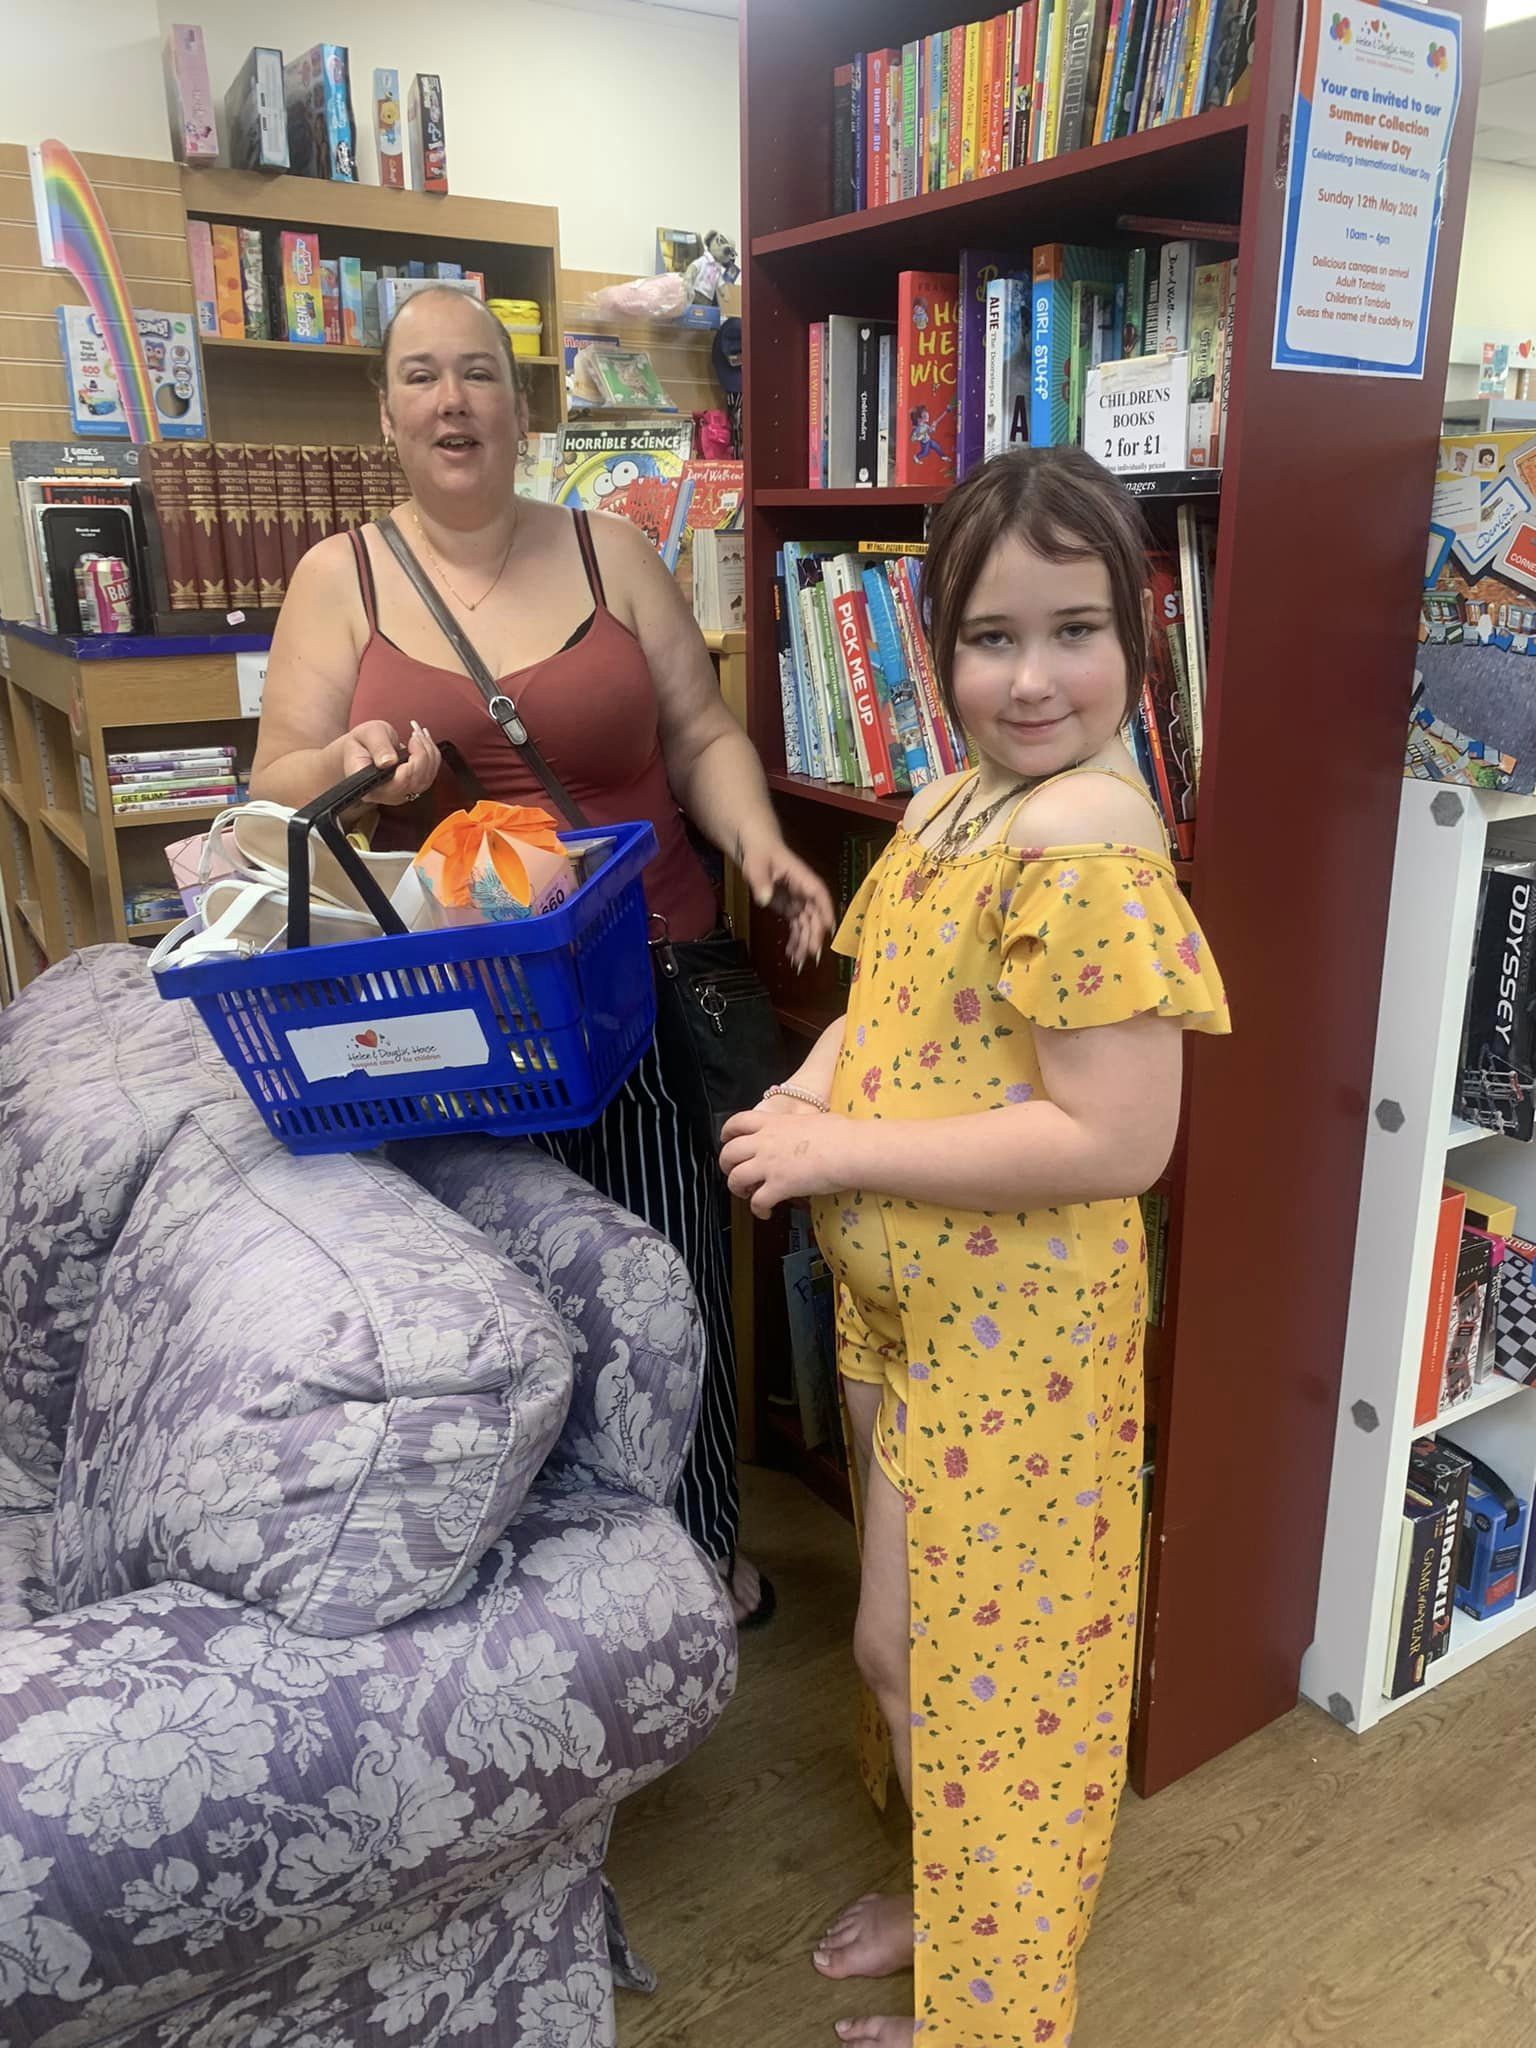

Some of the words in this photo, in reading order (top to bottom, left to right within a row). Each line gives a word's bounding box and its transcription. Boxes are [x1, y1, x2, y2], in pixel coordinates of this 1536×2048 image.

[1321, 78, 1348, 97] Your
[1350, 88, 1369, 101] are
[1372, 88, 1409, 110] invited
[1411, 98, 1422, 112] to
[1424, 104, 1442, 117] our
[1329, 104, 1376, 127] Summer
[1379, 114, 1430, 137] Collection
[1345, 131, 1390, 152] Preview
[1391, 140, 1412, 160] Day
[1312, 148, 1354, 167] Celebrating
[1355, 156, 1398, 173] International
[1318, 188, 1354, 209] Sunday
[1357, 194, 1377, 210] 12th
[1379, 198, 1398, 216] May
[1398, 202, 1419, 218] 2024
[1345, 227, 1368, 242] 10am
[1312, 255, 1346, 271] Delicious
[1336, 275, 1357, 288] Adult
[1325, 291, 1362, 306] Children's
[989, 297, 1000, 331] ALFIE
[1036, 297, 1049, 340] GIRL
[1297, 305, 1320, 318] Guess
[1321, 307, 1334, 320] the
[1335, 311, 1358, 323] name
[1099, 388, 1171, 409] CHILDRENS
[1113, 411, 1155, 428] BOOKS
[565, 431, 627, 450] HORRIBLE
[630, 431, 680, 450] SCIENCE
[1104, 439, 1112, 458] 2
[1118, 437, 1140, 457] for
[1143, 434, 1161, 455] £1
[838, 602, 860, 655] PICK
[850, 660, 867, 693] ME
[856, 699, 874, 726] UP
[121, 794, 139, 803] GET
[1495, 884, 1531, 1045] ODYSSEY
[1420, 1547, 1434, 1593] GAME
[1409, 1615, 1425, 1658] YEAR
